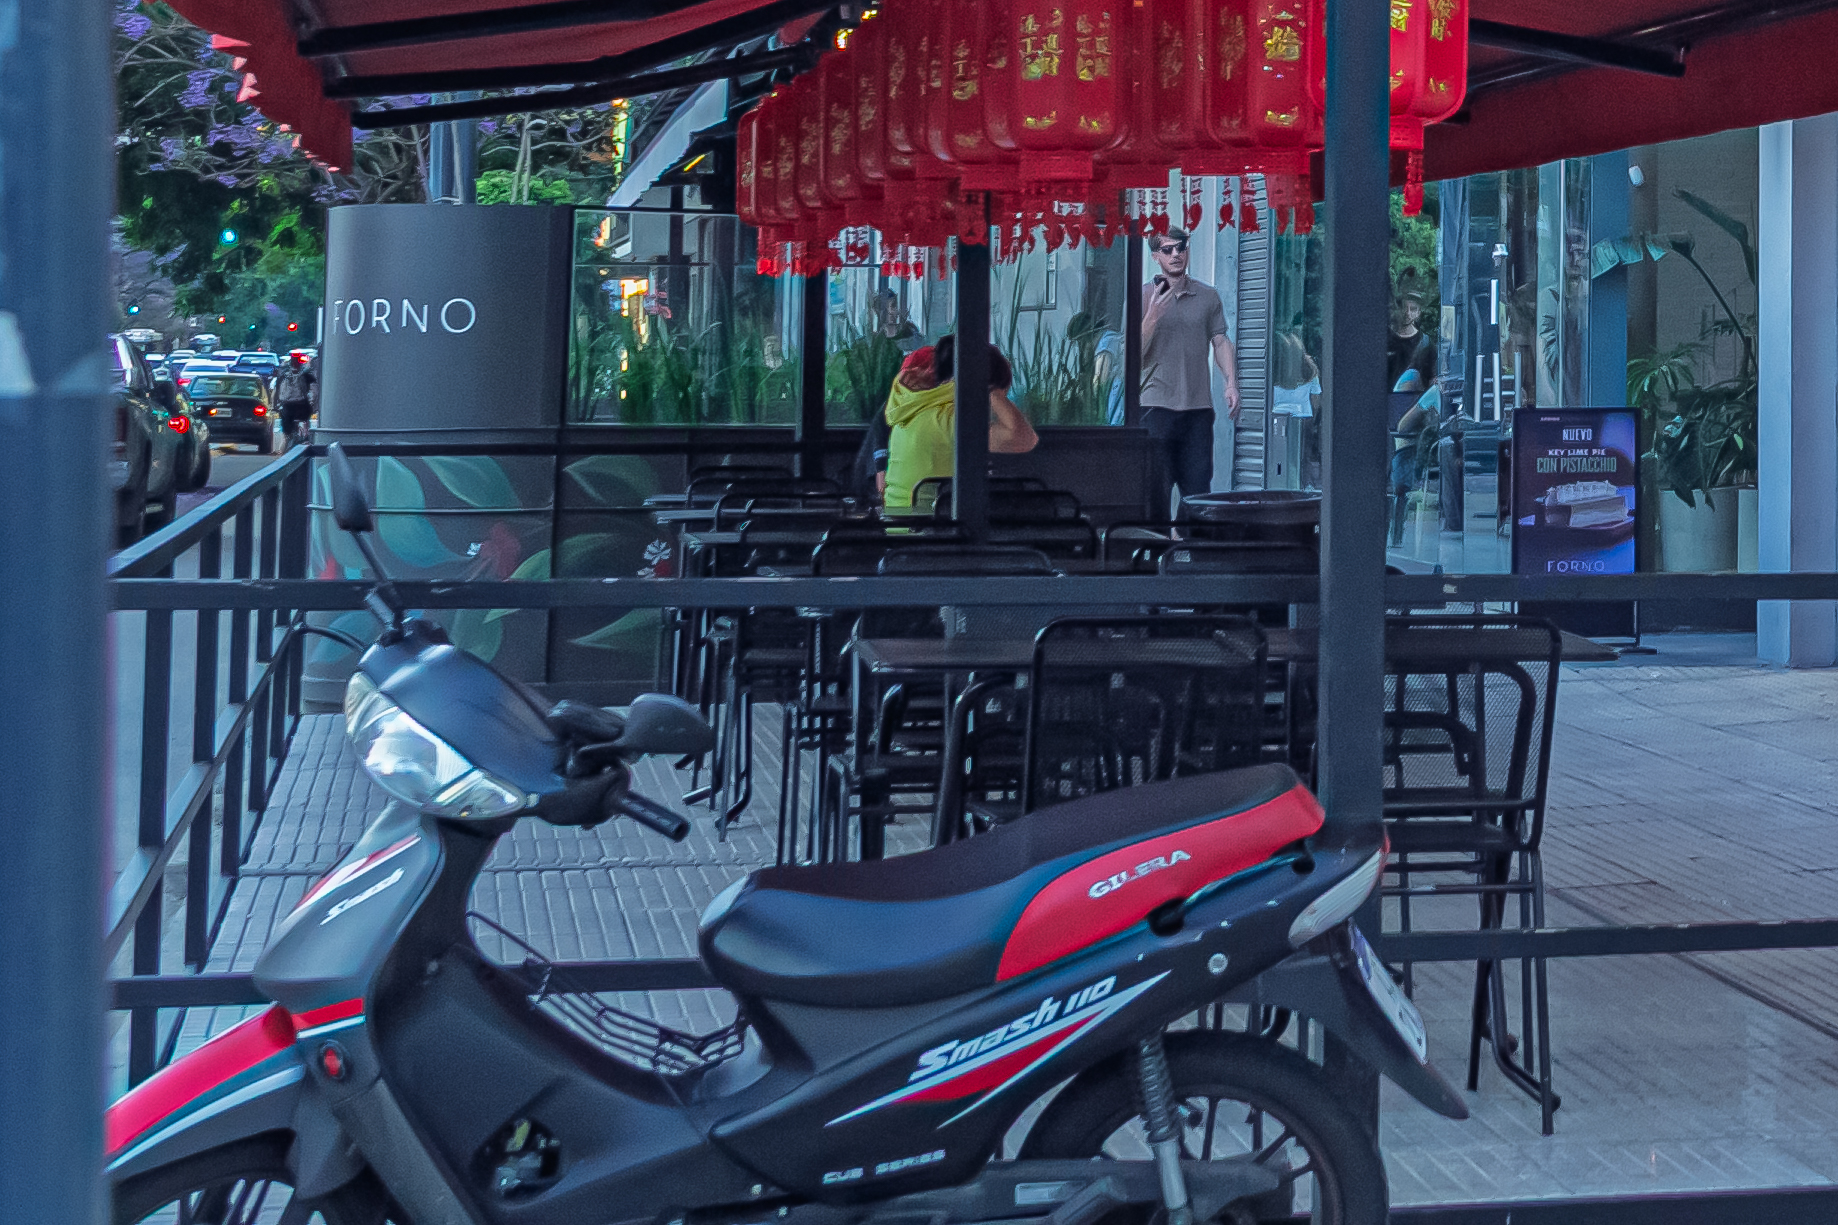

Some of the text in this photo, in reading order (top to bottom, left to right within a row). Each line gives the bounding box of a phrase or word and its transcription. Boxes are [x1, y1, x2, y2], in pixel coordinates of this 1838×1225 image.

[333, 297, 476, 335] FORNO
[1562, 428, 1593, 441] NUEVO
[1536, 456, 1617, 473] CON PISTACCHIO
[1088, 849, 1192, 899] GILERA
[908, 975, 1117, 1083] Smash 110
